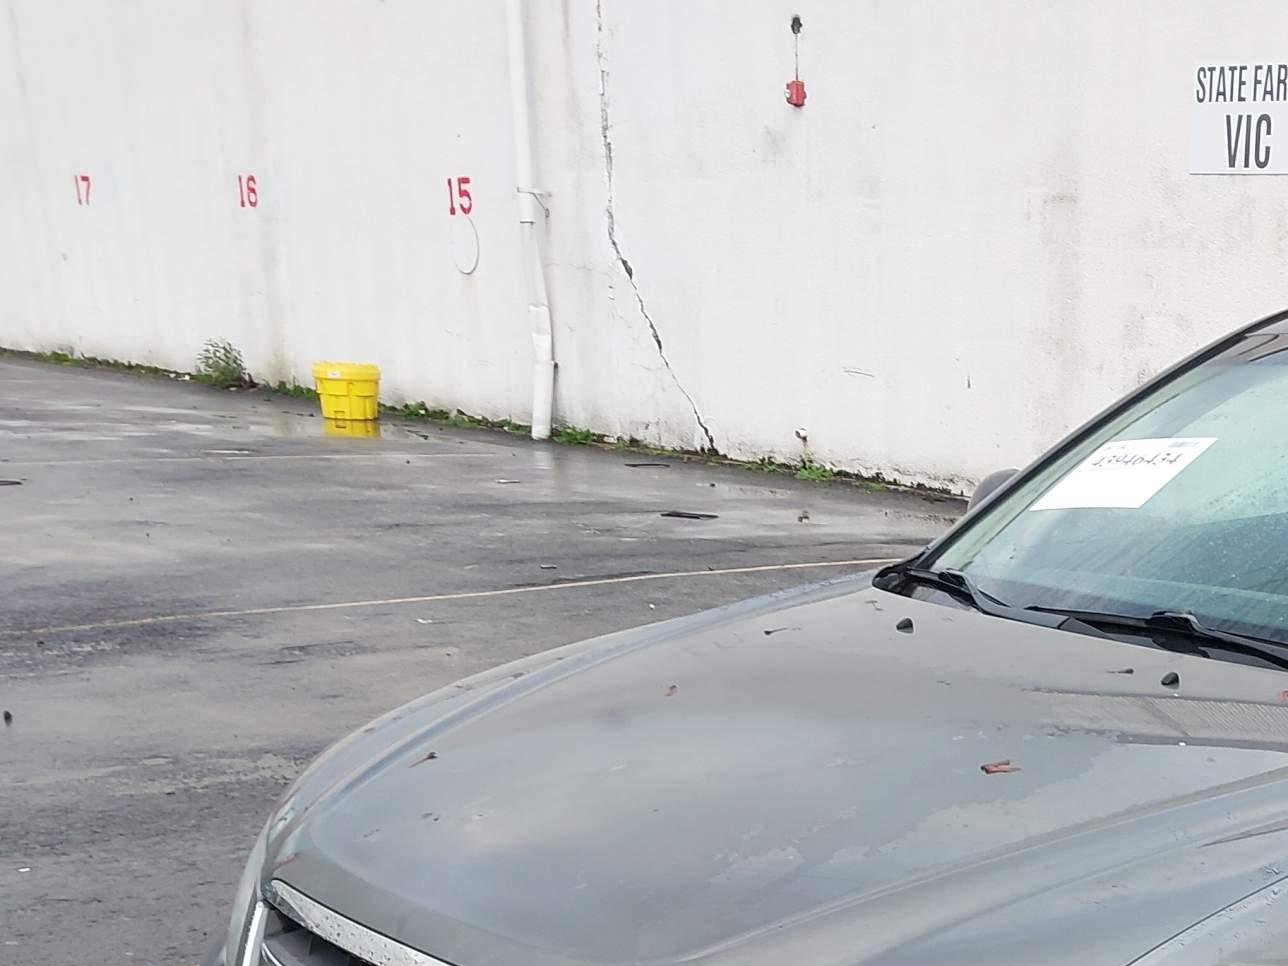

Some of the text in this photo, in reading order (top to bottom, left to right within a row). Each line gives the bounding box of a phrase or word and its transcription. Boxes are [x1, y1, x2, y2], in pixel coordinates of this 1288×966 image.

[1195, 65, 1248, 103] STATE
[1225, 113, 1272, 169] VIC
[73, 175, 92, 206] 17
[237, 175, 258, 208] 16
[447, 177, 472, 215] 15
